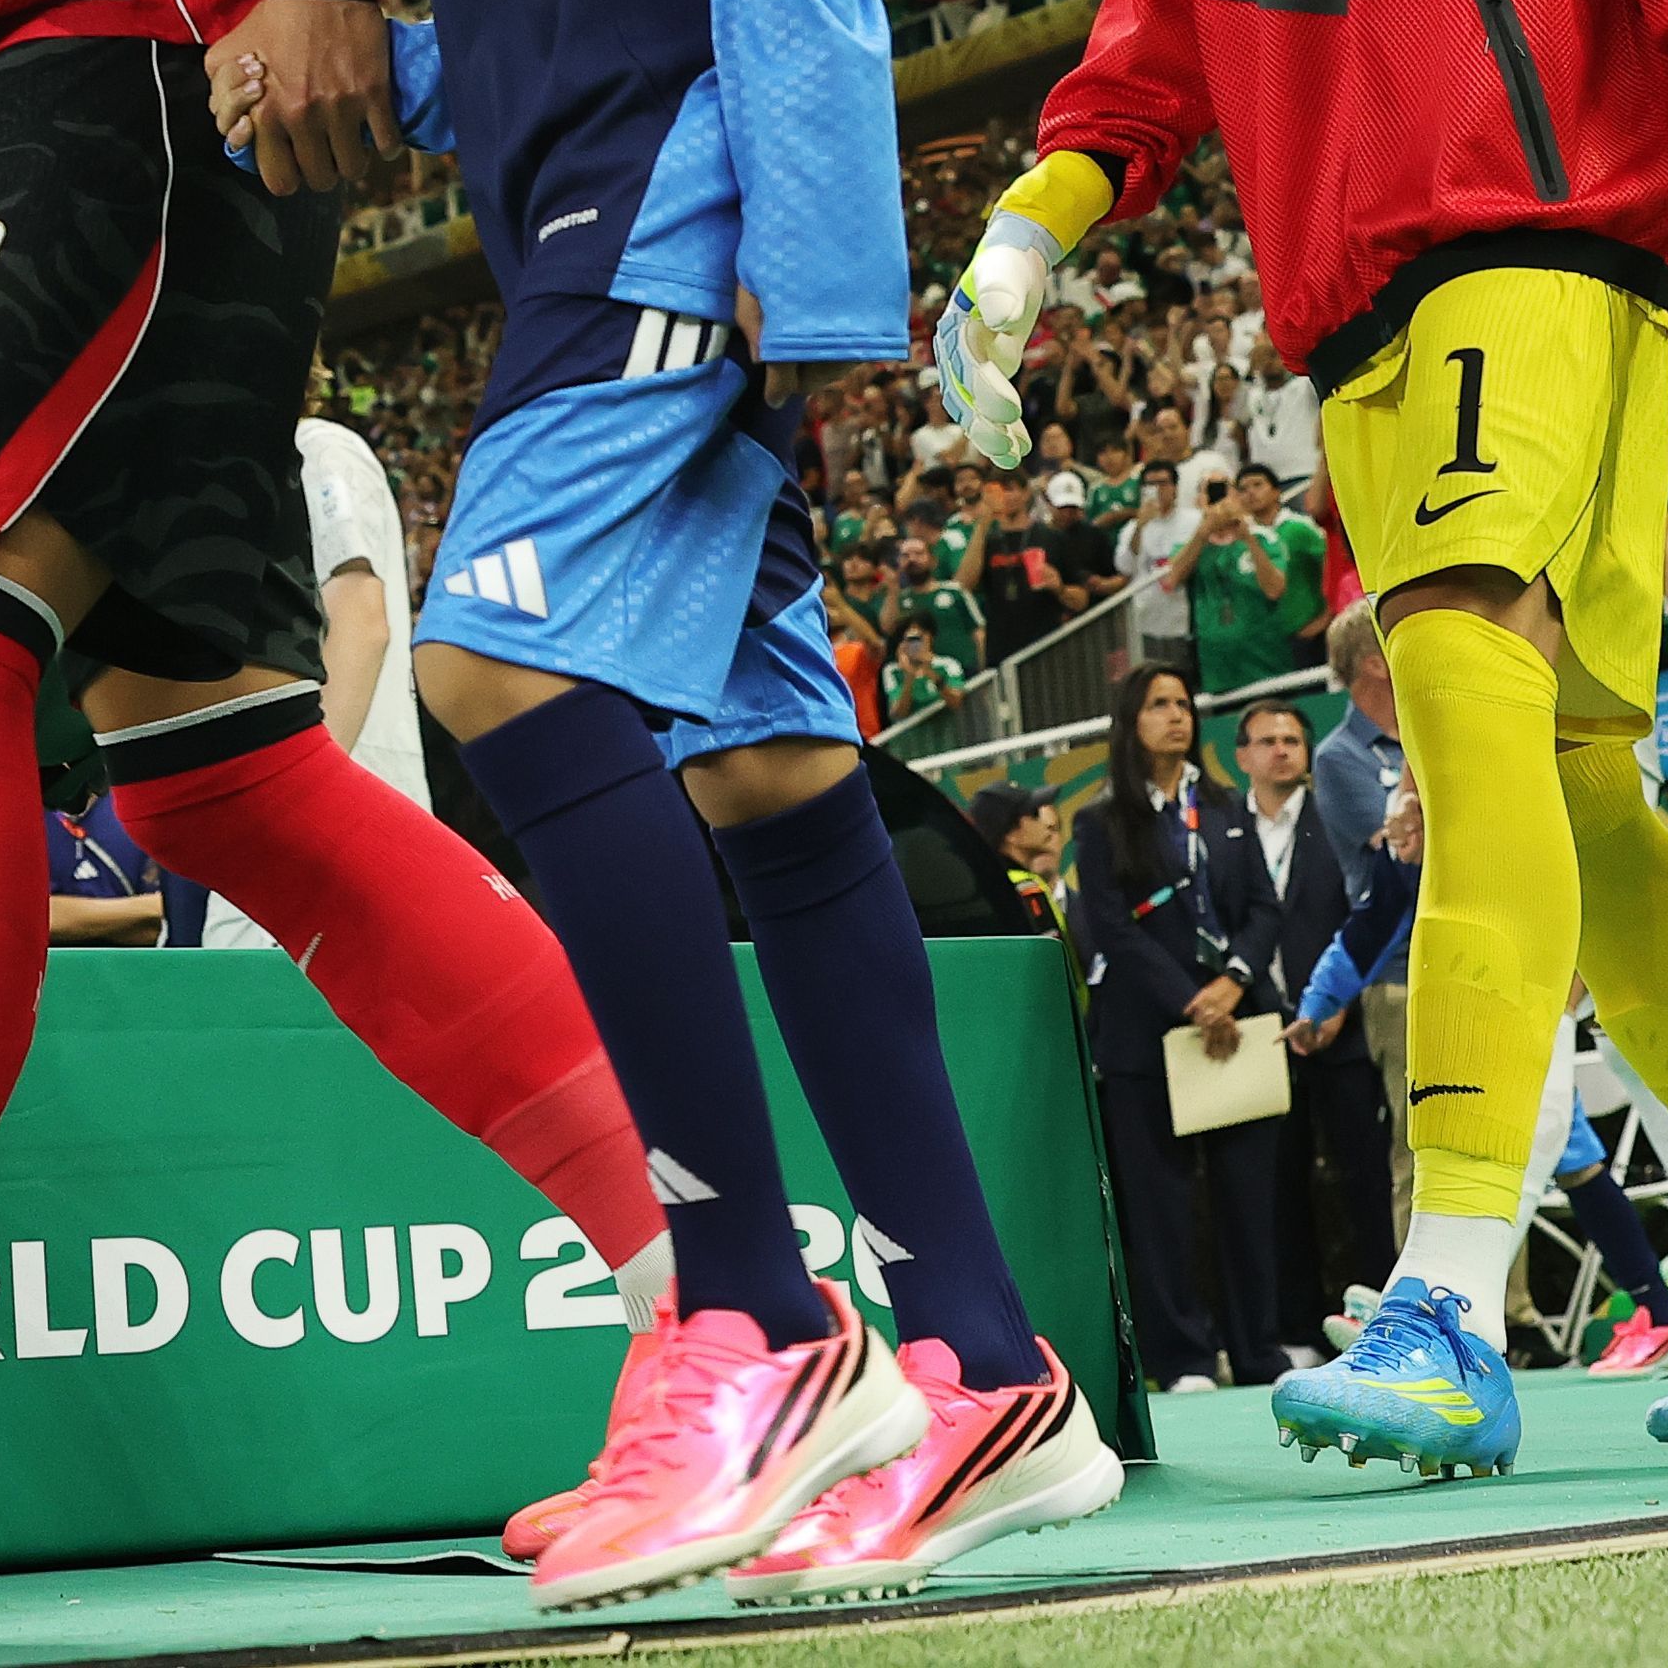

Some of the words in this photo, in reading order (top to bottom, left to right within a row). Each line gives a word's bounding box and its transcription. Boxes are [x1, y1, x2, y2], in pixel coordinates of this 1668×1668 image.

[1435, 347, 1498, 479] 1
[220, 1222, 491, 1350] CUP
[519, 1204, 895, 1331] 22
